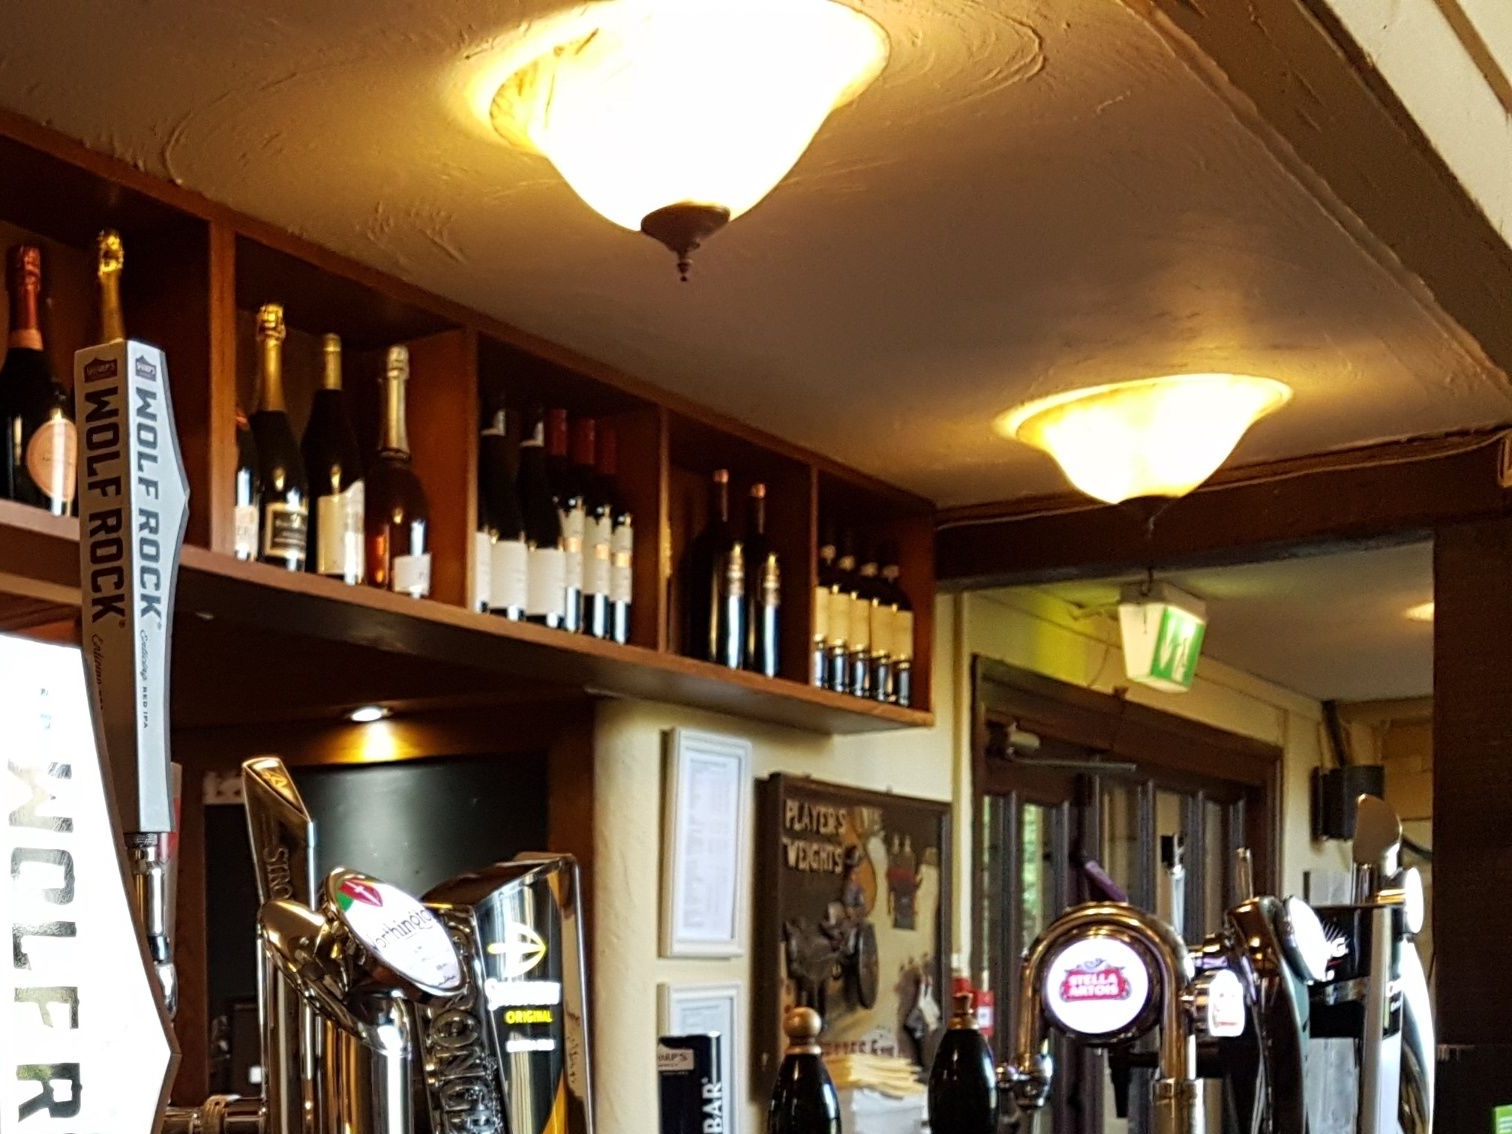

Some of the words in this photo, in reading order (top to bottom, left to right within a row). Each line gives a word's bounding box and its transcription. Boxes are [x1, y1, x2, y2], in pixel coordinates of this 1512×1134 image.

[84, 385, 122, 498] WOLF
[135, 386, 159, 501] WOLF
[88, 507, 126, 624] ROCK
[138, 507, 162, 626] ROCK
[504, 1009, 553, 1024] ORIGINAL
